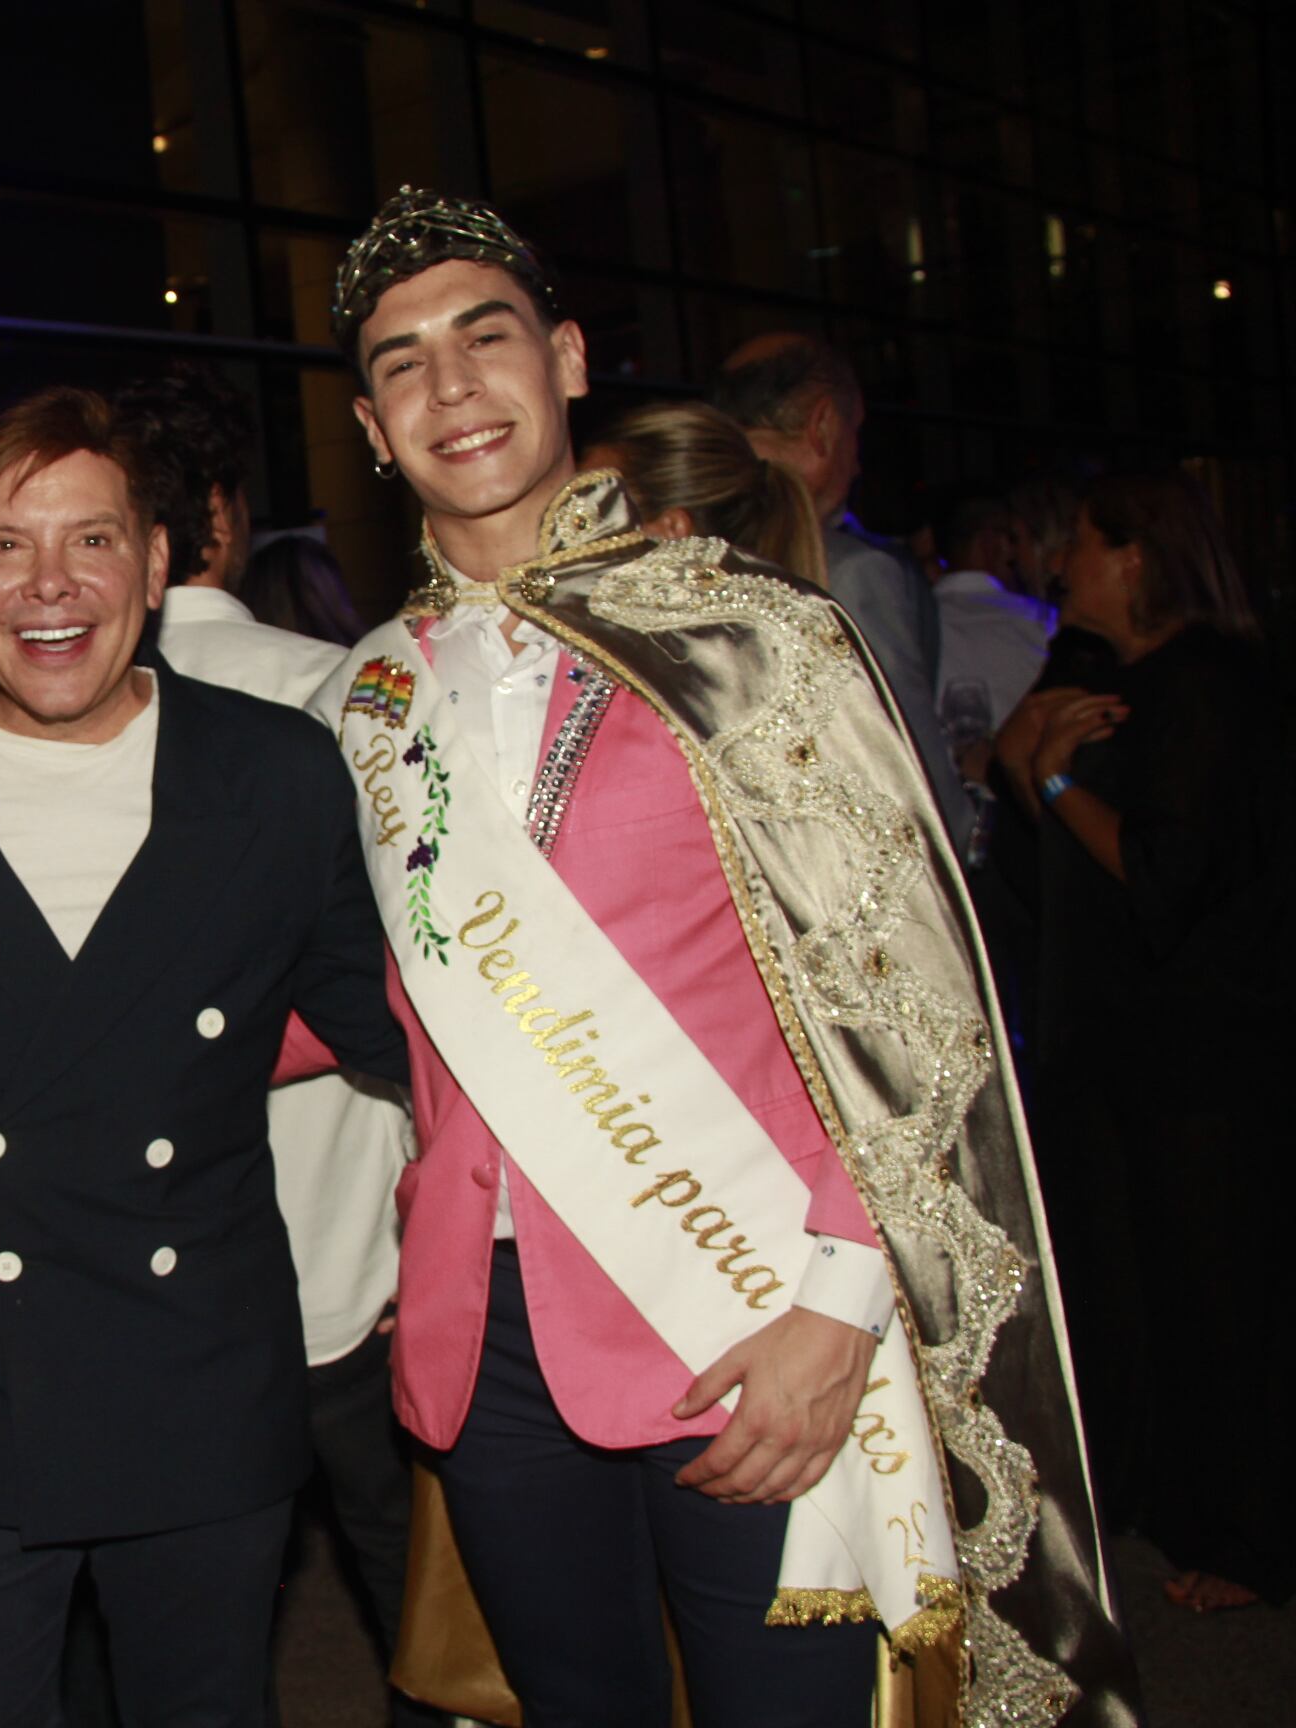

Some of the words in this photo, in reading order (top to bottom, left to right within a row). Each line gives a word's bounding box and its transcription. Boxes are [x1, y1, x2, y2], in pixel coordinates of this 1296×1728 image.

[352, 733, 407, 847] Rey
[458, 890, 662, 1165] Vendimia
[629, 1168, 784, 1310] para
